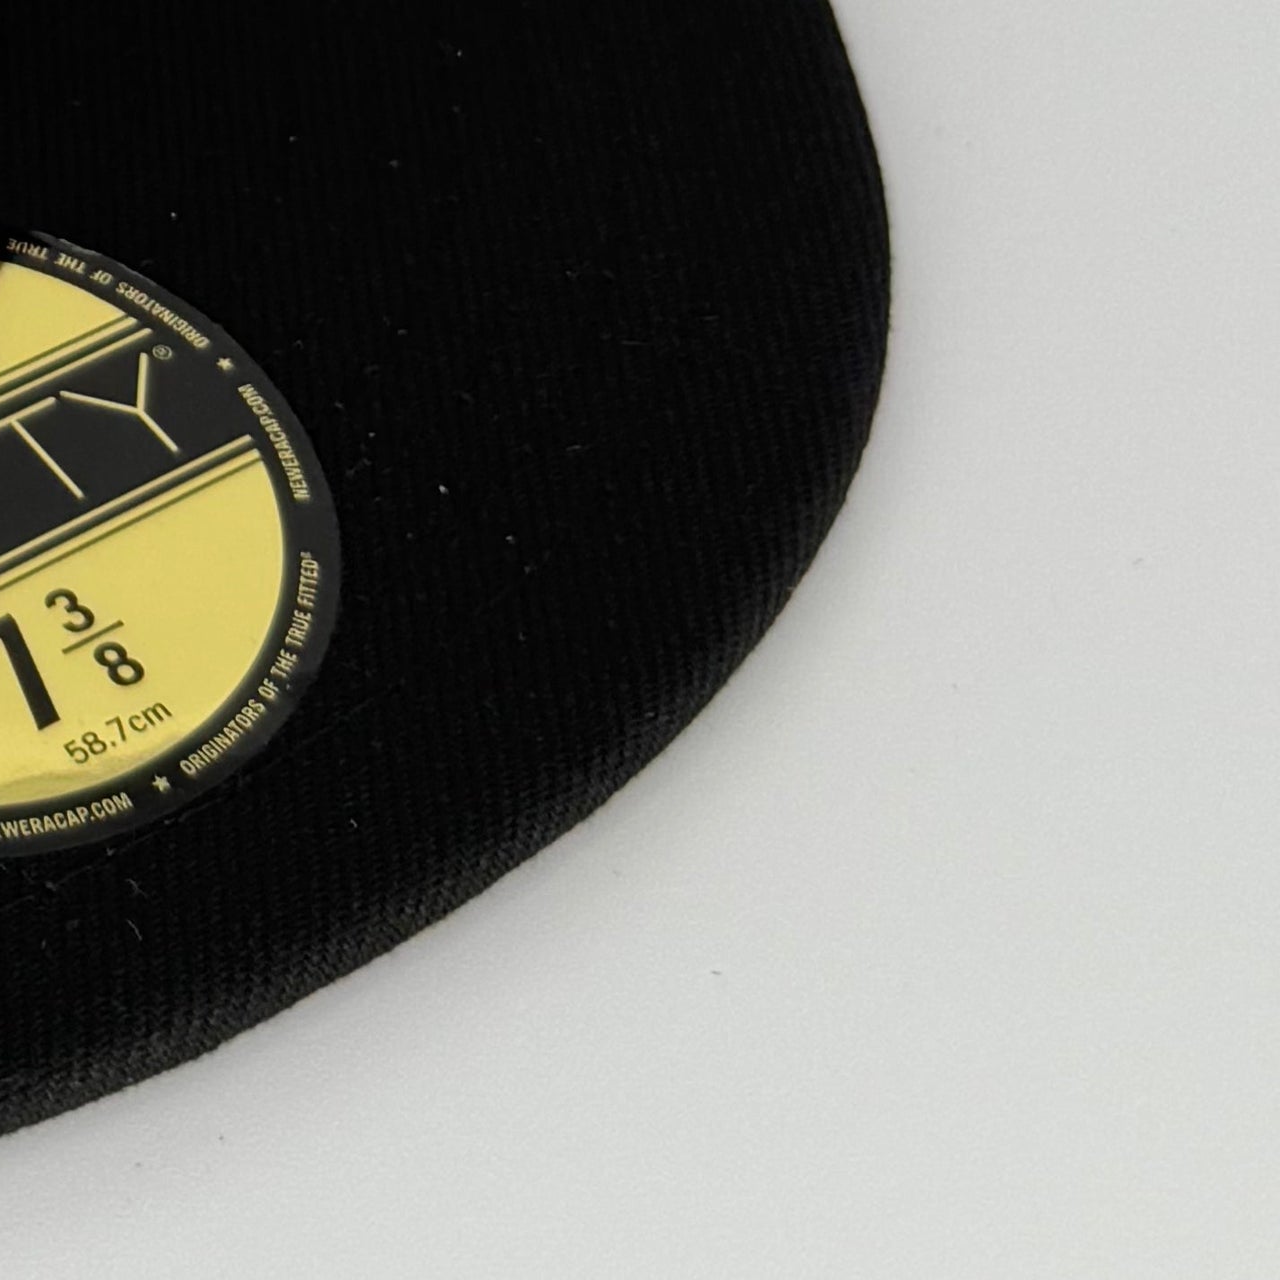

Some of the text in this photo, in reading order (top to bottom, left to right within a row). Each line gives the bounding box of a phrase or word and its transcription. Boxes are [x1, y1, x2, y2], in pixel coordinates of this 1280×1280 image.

[6, 237, 49, 261] TRUE
[54, 252, 88, 273] THE
[89, 269, 114, 287] OF
[115, 281, 210, 349] ORIGINATORS
[237, 382, 311, 502] NEWERACAP.COM
[284, 609, 313, 648] TRUE
[270, 648, 299, 679] THE
[258, 678, 280, 701] OF
[62, 701, 174, 765] 58.7cm
[179, 698, 267, 777] ORIGINATORS
